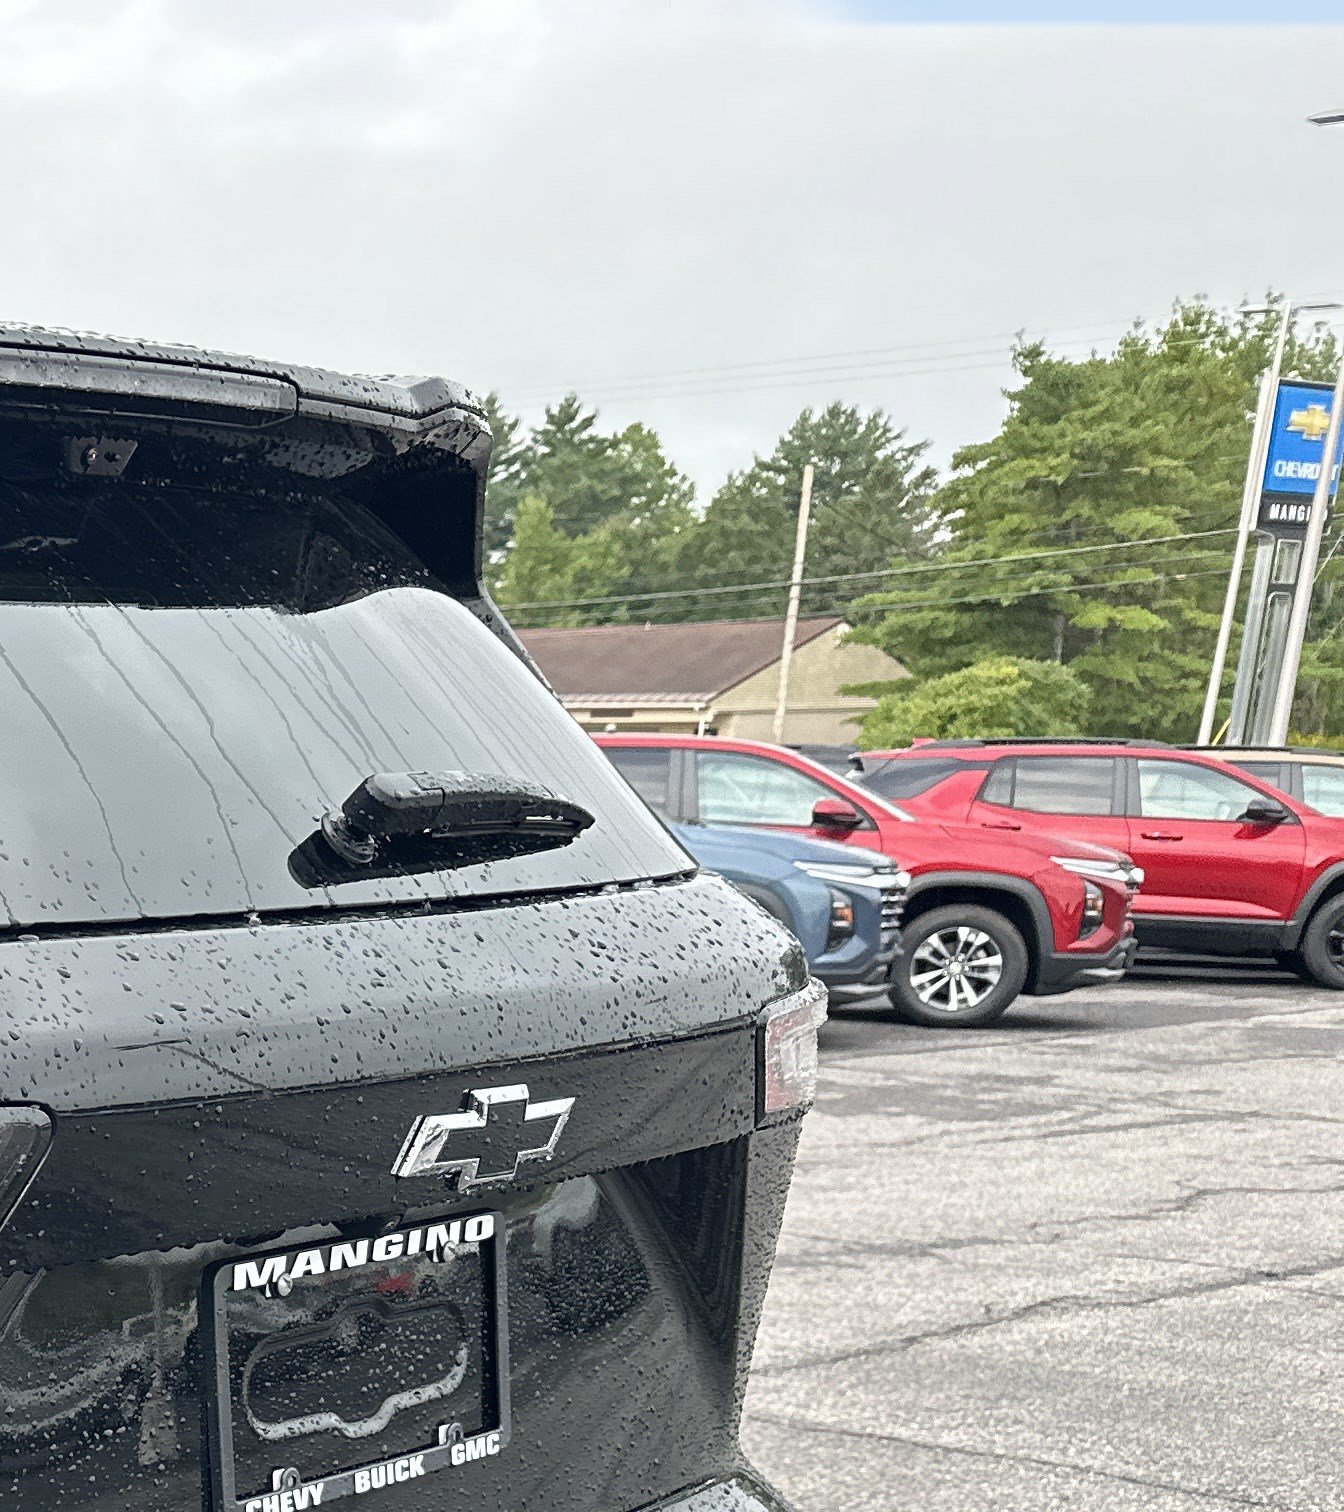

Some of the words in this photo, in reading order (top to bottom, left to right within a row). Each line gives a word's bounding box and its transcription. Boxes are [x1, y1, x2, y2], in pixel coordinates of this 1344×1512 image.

[1274, 459, 1339, 481] CHEVROT
[1270, 503, 1328, 522] MANGI
[233, 1214, 495, 1298] MANGINO
[353, 1454, 426, 1495] BUICK
[450, 1432, 501, 1467] GMC
